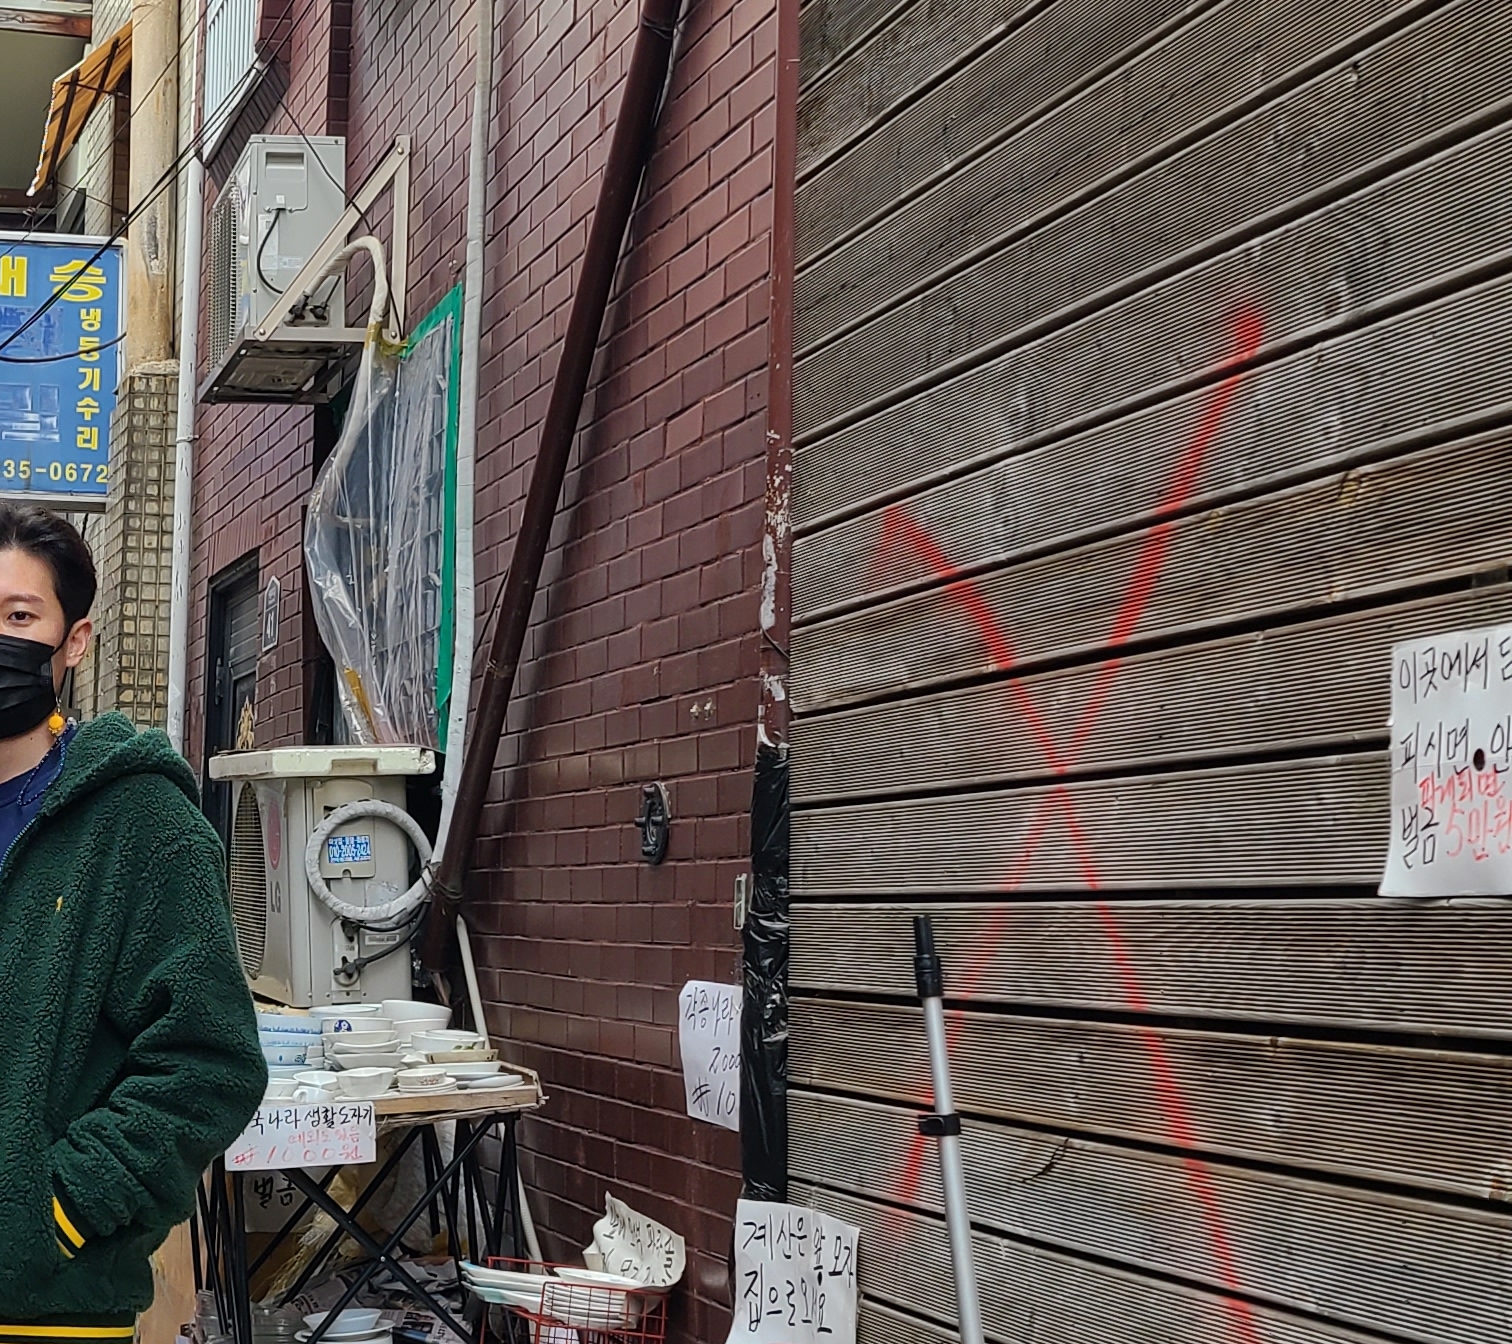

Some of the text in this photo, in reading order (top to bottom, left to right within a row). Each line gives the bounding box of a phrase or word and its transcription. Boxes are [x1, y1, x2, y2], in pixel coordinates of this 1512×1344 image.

[74, 307, 103, 451] 냉동기수리
[1399, 636, 1489, 704] 이곳에서
[1399, 718, 1469, 784] 피시면
[1401, 803, 1440, 870] 벌금
[270, 881, 281, 914] LG
[742, 1211, 808, 1261] 계산은
[827, 1235, 854, 1289] 모자
